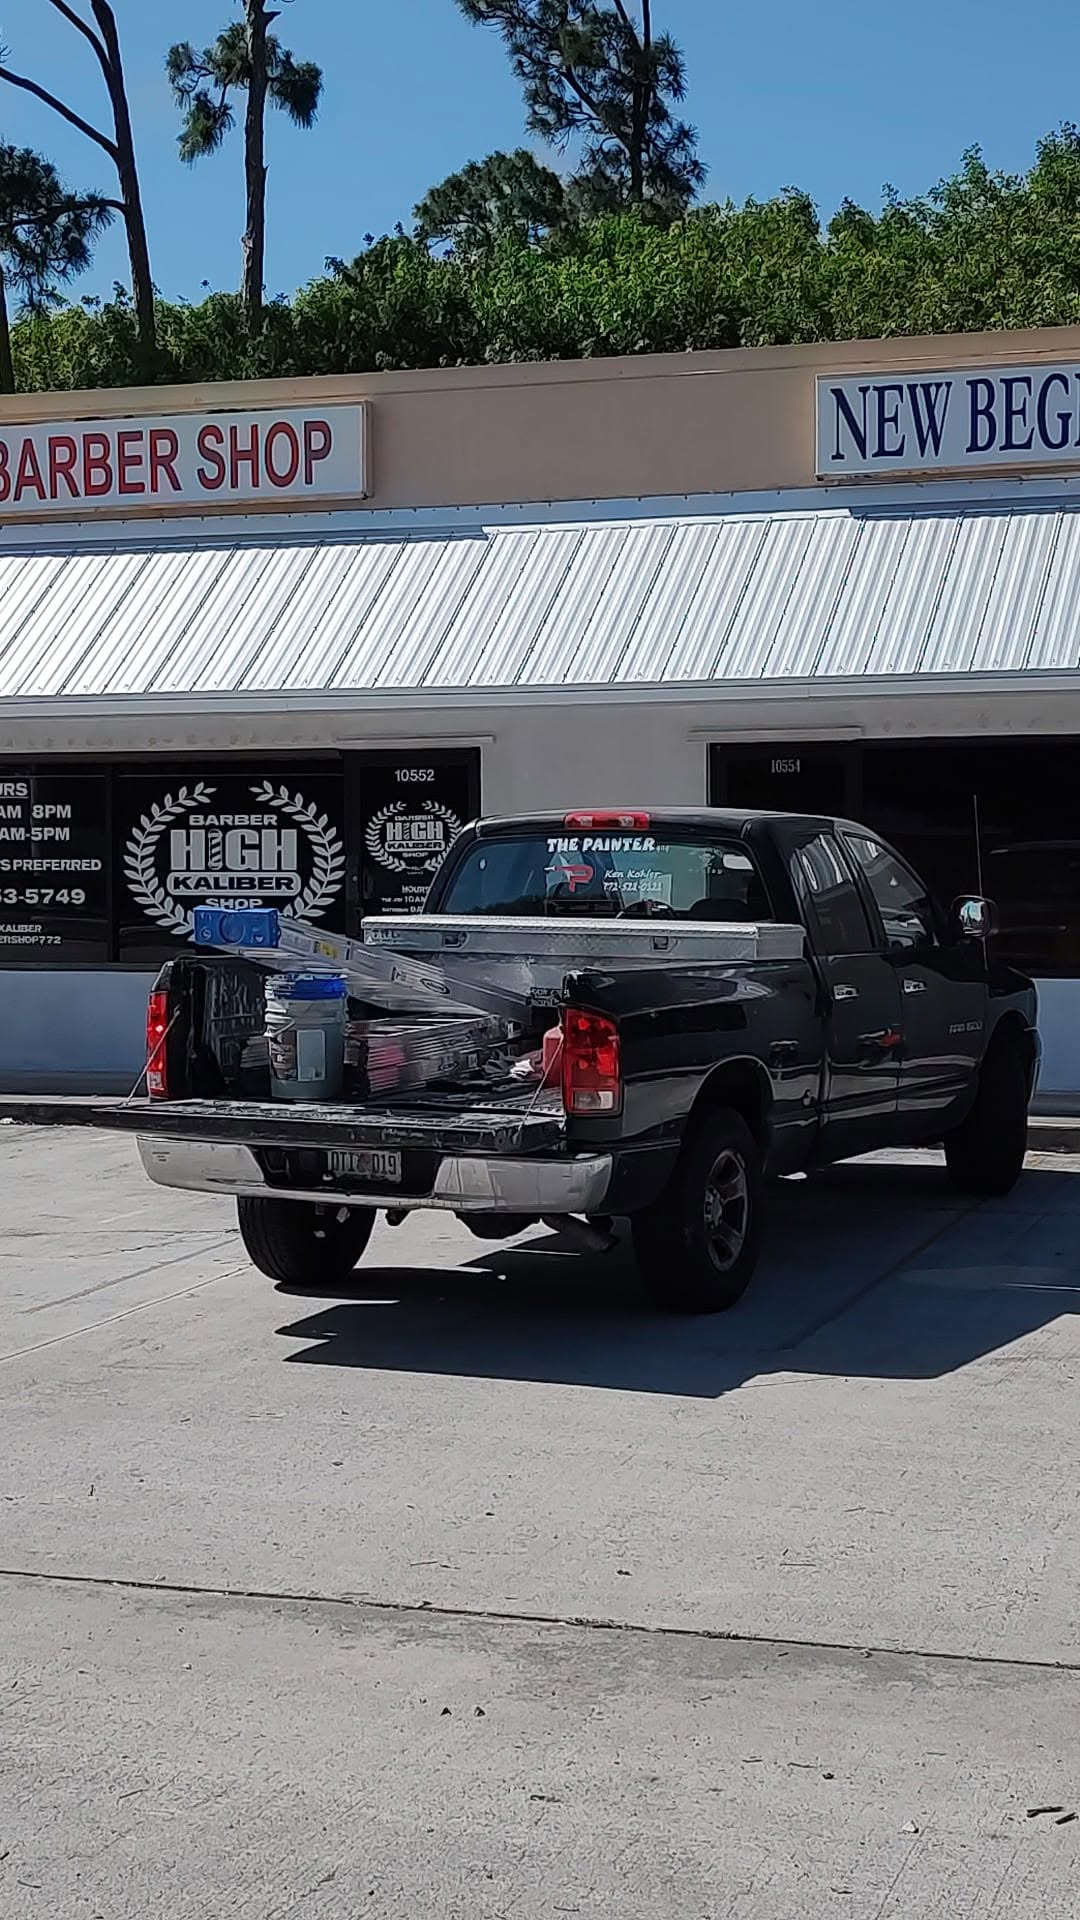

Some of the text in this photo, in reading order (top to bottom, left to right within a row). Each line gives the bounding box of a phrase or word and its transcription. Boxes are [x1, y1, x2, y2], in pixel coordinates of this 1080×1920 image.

[830, 381, 953, 460] NEW
[197, 420, 332, 490] SHOP
[394, 769, 435, 782] 10552
[0, 783, 28, 797] RS
[188, 815, 278, 826] BARBER
[386, 821, 443, 840] HIGH
[170, 828, 298, 870] HIGH
[546, 838, 579, 852] THE
[582, 837, 655, 852] PAINTER
[12, 859, 102, 871] PREFERRED
[173, 876, 295, 890] KALIBER
[0, 888, 86, 904] 3-5749
[205, 898, 263, 911] SHOP
